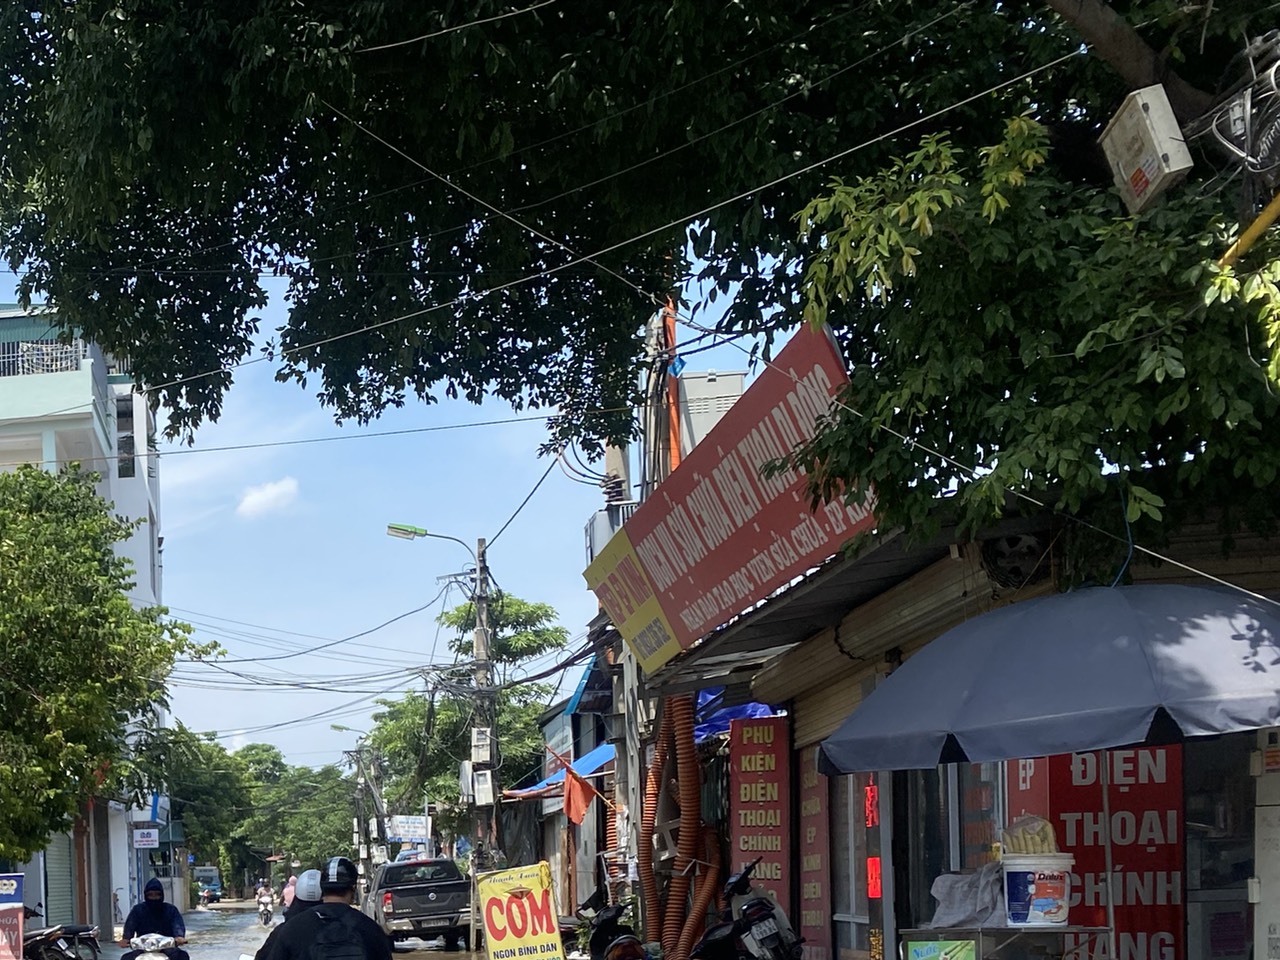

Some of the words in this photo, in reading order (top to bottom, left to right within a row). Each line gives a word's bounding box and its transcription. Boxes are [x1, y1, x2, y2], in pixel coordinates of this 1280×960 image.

[710, 444, 764, 533] ĐIỆN
[683, 468, 736, 550] CHỮA
[662, 490, 708, 567] SỬA
[678, 600, 706, 632] NHẬN
[696, 587, 721, 620] ĐÀO
[712, 579, 737, 613] TẠO
[728, 566, 756, 600] HỌC
[746, 547, 779, 586] VIÊN
[768, 529, 799, 571] SỬA
[789, 511, 828, 557] CHỮA
[742, 724, 774, 747] PHỤ
[741, 750, 776, 775] KIỆN
[740, 779, 778, 806] ĐIỆN
[738, 809, 781, 831] THOẠI
[1060, 809, 1178, 853] THOẠI
[739, 832, 781, 852] CHÍNH
[1070, 864, 1181, 907] CHÍNH
[493, 948, 516, 960] NGON
